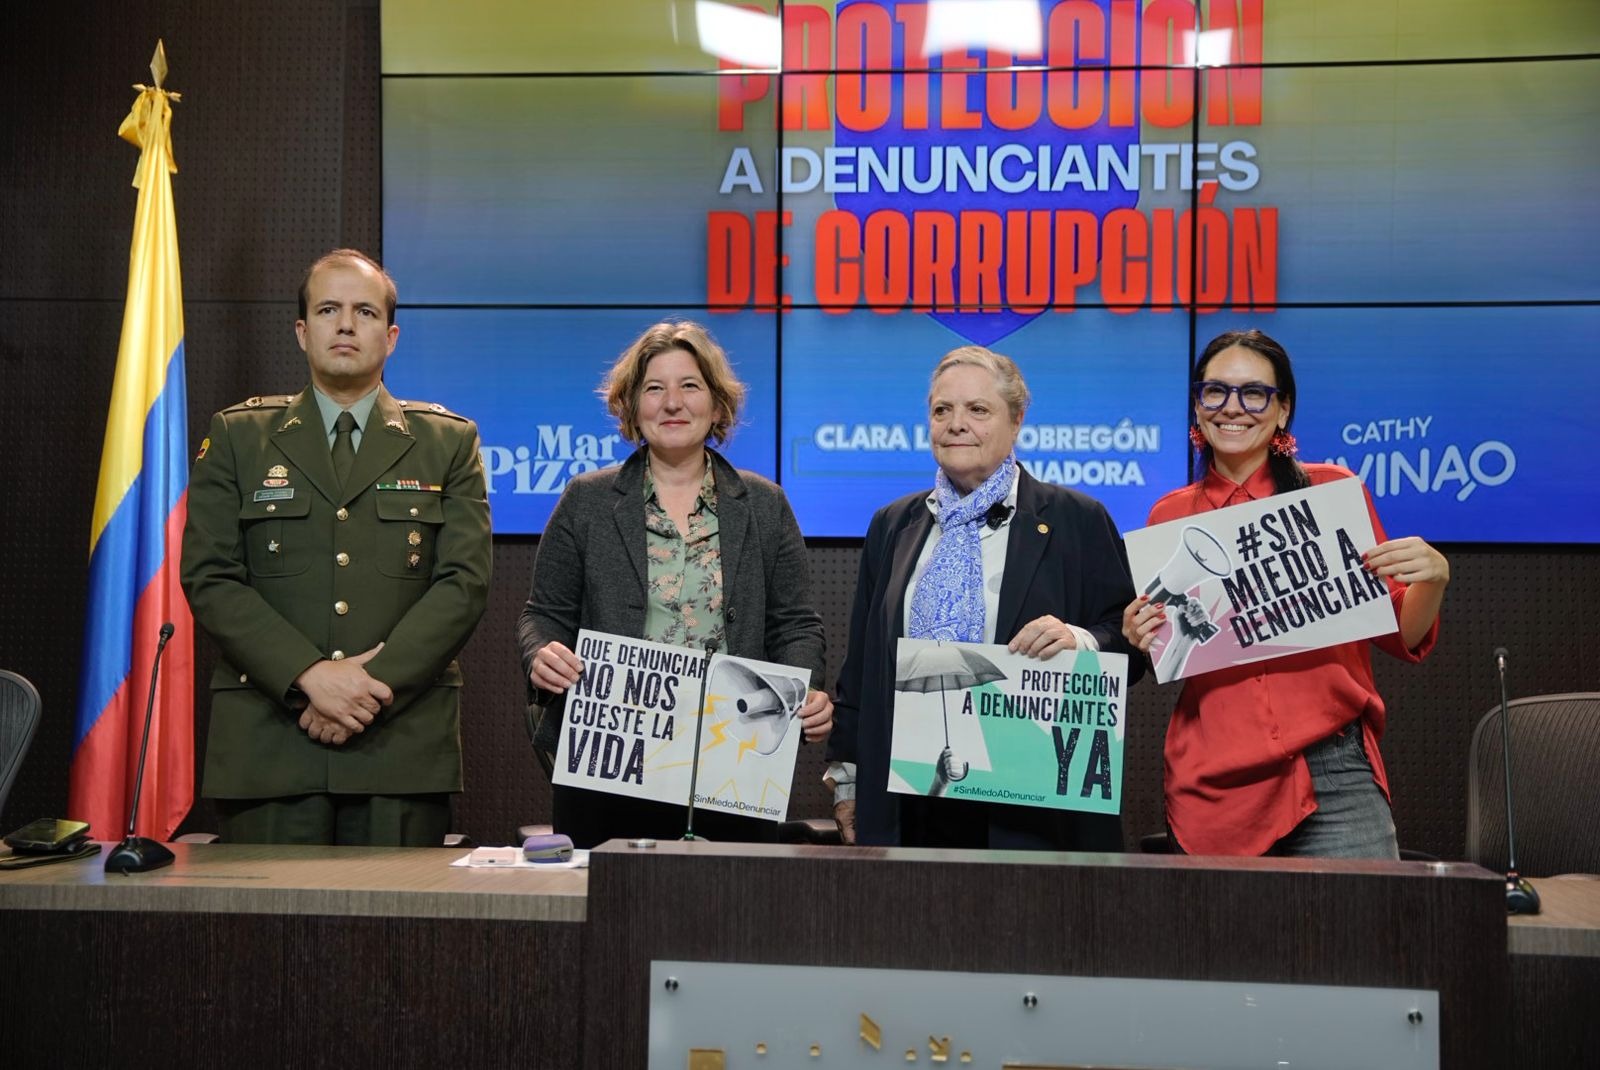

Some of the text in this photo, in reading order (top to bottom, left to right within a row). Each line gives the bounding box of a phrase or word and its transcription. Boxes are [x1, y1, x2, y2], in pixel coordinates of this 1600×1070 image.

[719, 140, 1261, 194] A DENUNCIANTES
[707, 181, 1279, 314] DE CORRUPCIÓN
[815, 424, 912, 451] CLARA
[1017, 417, 1160, 451] OBREGÓN
[1341, 415, 1433, 446] CATHY
[1021, 460, 1146, 486] NADORA
[1236, 499, 1321, 562] #SIN
[1221, 527, 1364, 614] MIEDO A
[1229, 568, 1388, 649] DENUNCIAR
[580, 637, 612, 662] QUE
[574, 660, 679, 712] NO NOS
[1021, 669, 1120, 698] PROTECCIÓN
[569, 698, 675, 741] CUESTE LA
[961, 691, 1119, 727] A DENUNCIANTES
[567, 726, 645, 785] VIDA
[1051, 725, 1112, 800] YA
[693, 793, 781, 816] SinMiedoADenunciar
[953, 785, 1047, 802] #SinMiedoADenunciar
